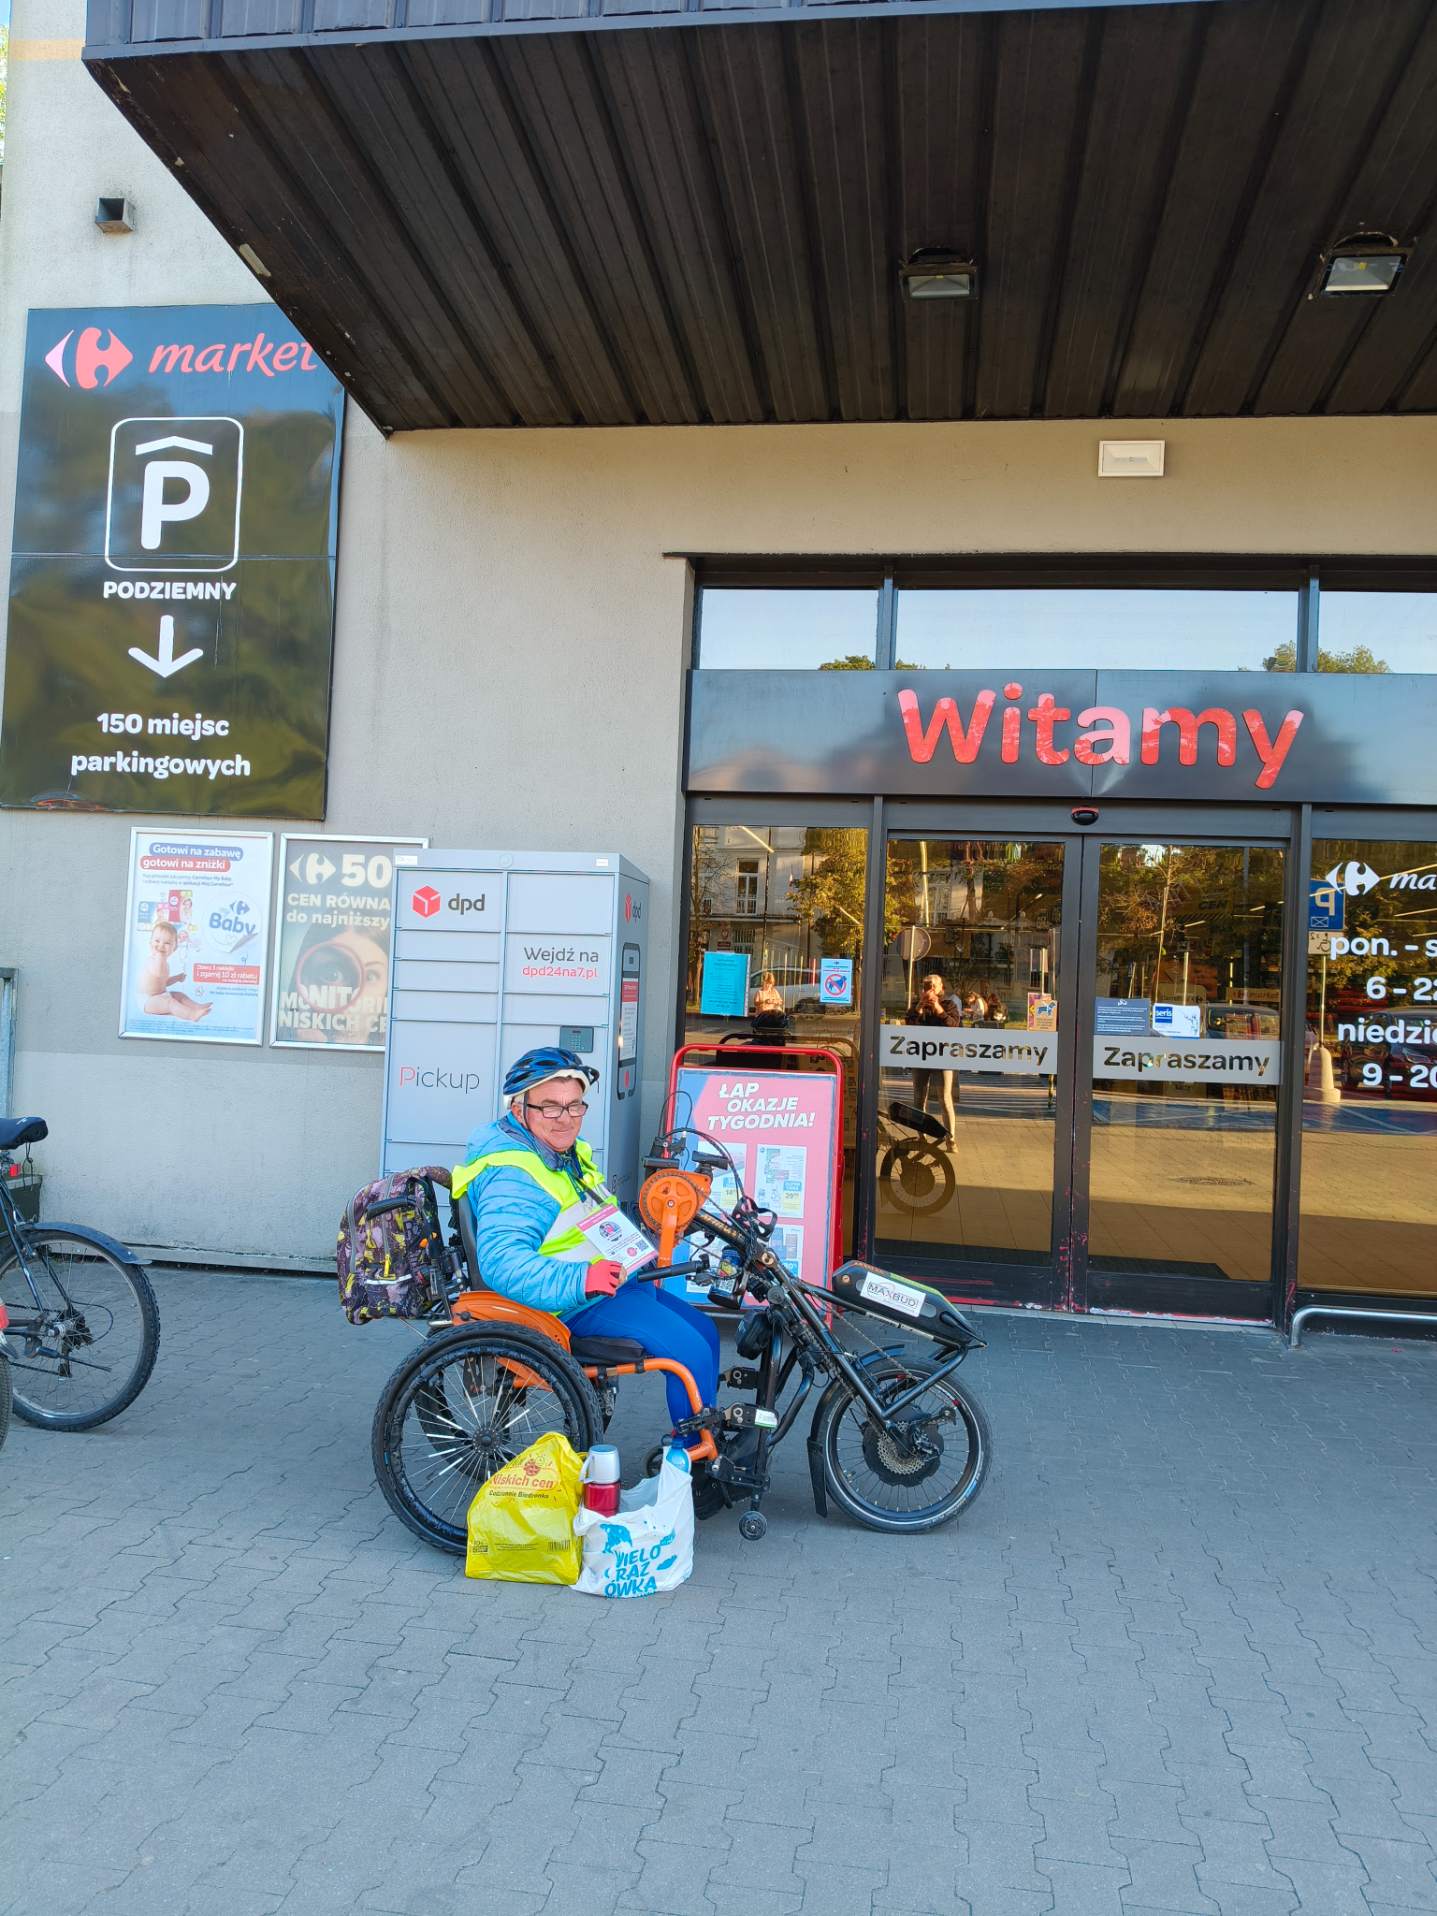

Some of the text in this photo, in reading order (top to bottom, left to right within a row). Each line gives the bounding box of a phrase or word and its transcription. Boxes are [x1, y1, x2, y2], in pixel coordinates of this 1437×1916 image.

[148, 332, 318, 377] market
[141, 460, 211, 550] P
[103, 581, 237, 600] PODZIEMNY
[97, 714, 229, 742] 150 miejsc
[898, 682, 1304, 789] Witamy
[71, 750, 251, 779] parkingowych
[153, 844, 188, 855] Gotowi
[190, 847, 202, 856] na
[143, 859, 179, 869] gotowi
[287, 891, 391, 910] CEN RÓWNA
[448, 893, 485, 915] dpd
[209, 912, 256, 934] Baby
[286, 909, 307, 923] do
[523, 946, 599, 964] Wejdź na
[1330, 937, 1398, 960] pon.
[522, 966, 599, 980] dpd24na7.pl
[1366, 976, 1386, 999] 6
[1413, 977, 1437, 1001] 2
[889, 1036, 1048, 1066] Zapraszamy
[1103, 1045, 1270, 1077] Zapraszamy
[399, 1065, 480, 1094] Pickup
[1362, 1063, 1382, 1086] 9
[719, 1083, 760, 1098] ŁAP
[727, 1097, 798, 1112] OKAZJE
[707, 1113, 815, 1131] TYGODNIA!
[616, 1561, 650, 1582] RAZ
[604, 1576, 657, 1598] ÓWKA
